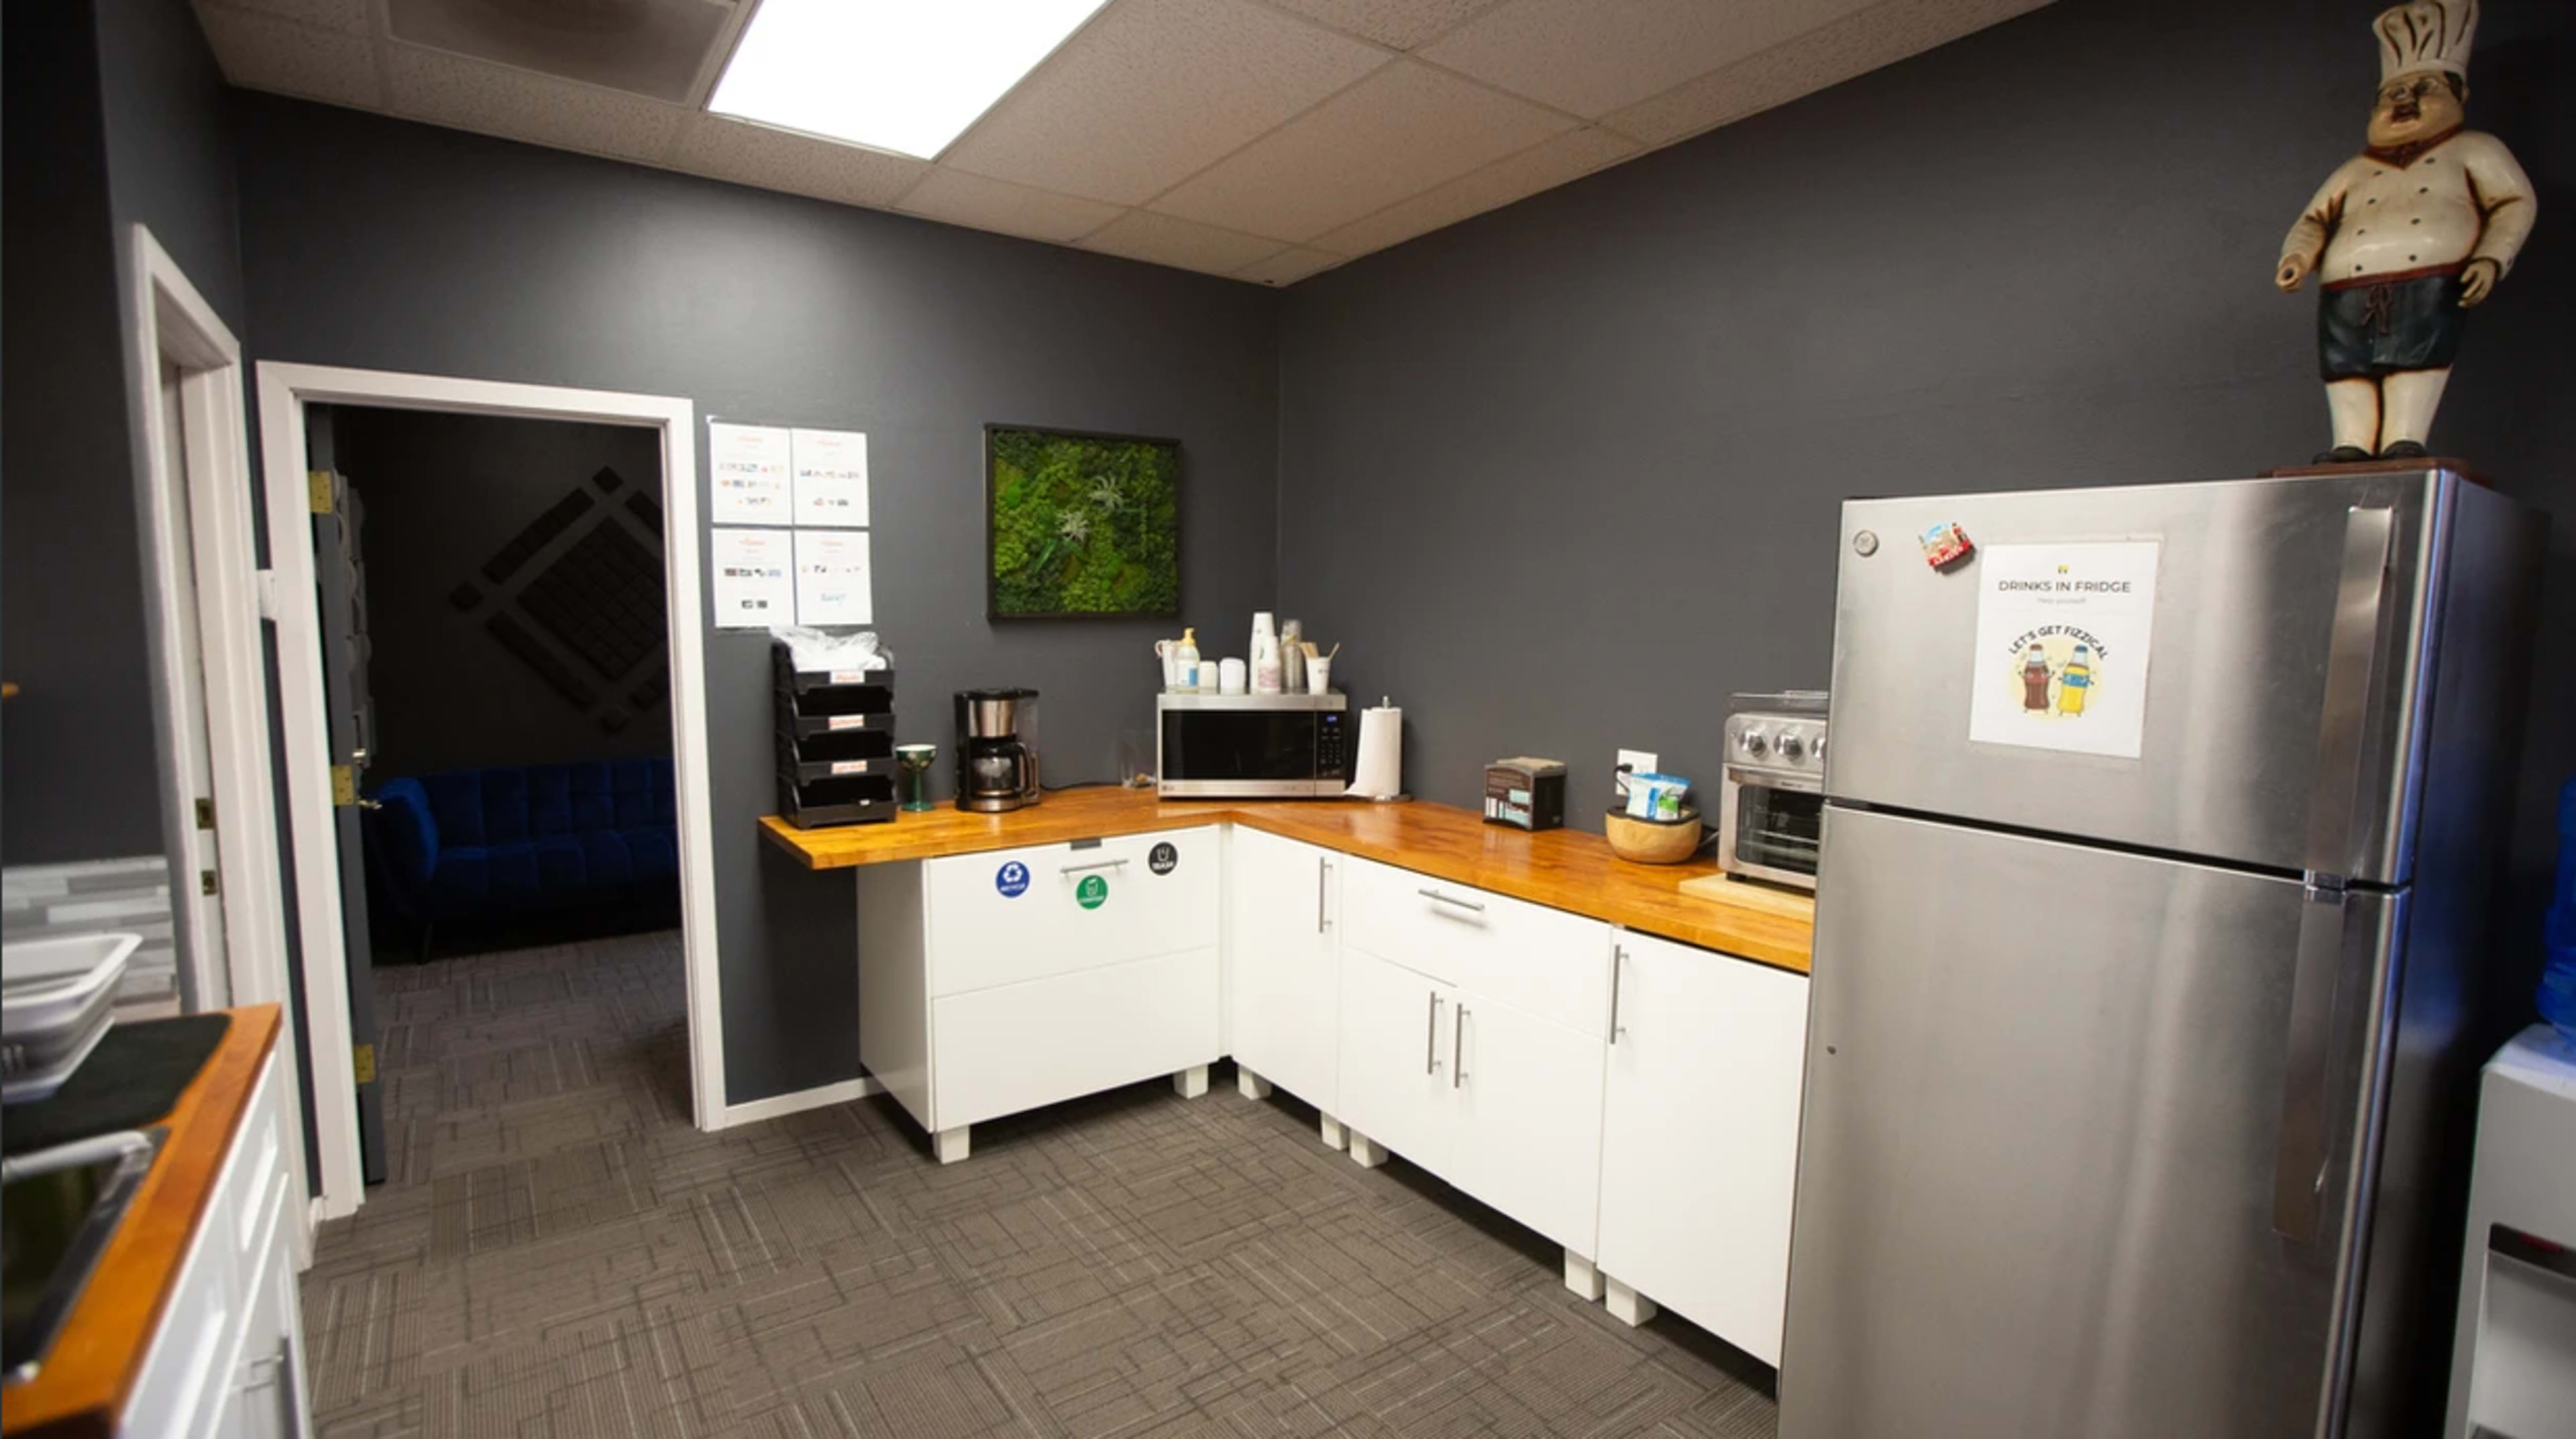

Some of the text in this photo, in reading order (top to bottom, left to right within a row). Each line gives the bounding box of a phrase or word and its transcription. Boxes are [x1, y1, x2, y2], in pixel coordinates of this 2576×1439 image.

[1998, 580, 2131, 593] DRINKS IN FRIDGE
[2008, 625, 2108, 659] LET'S GET FIZZICAL
